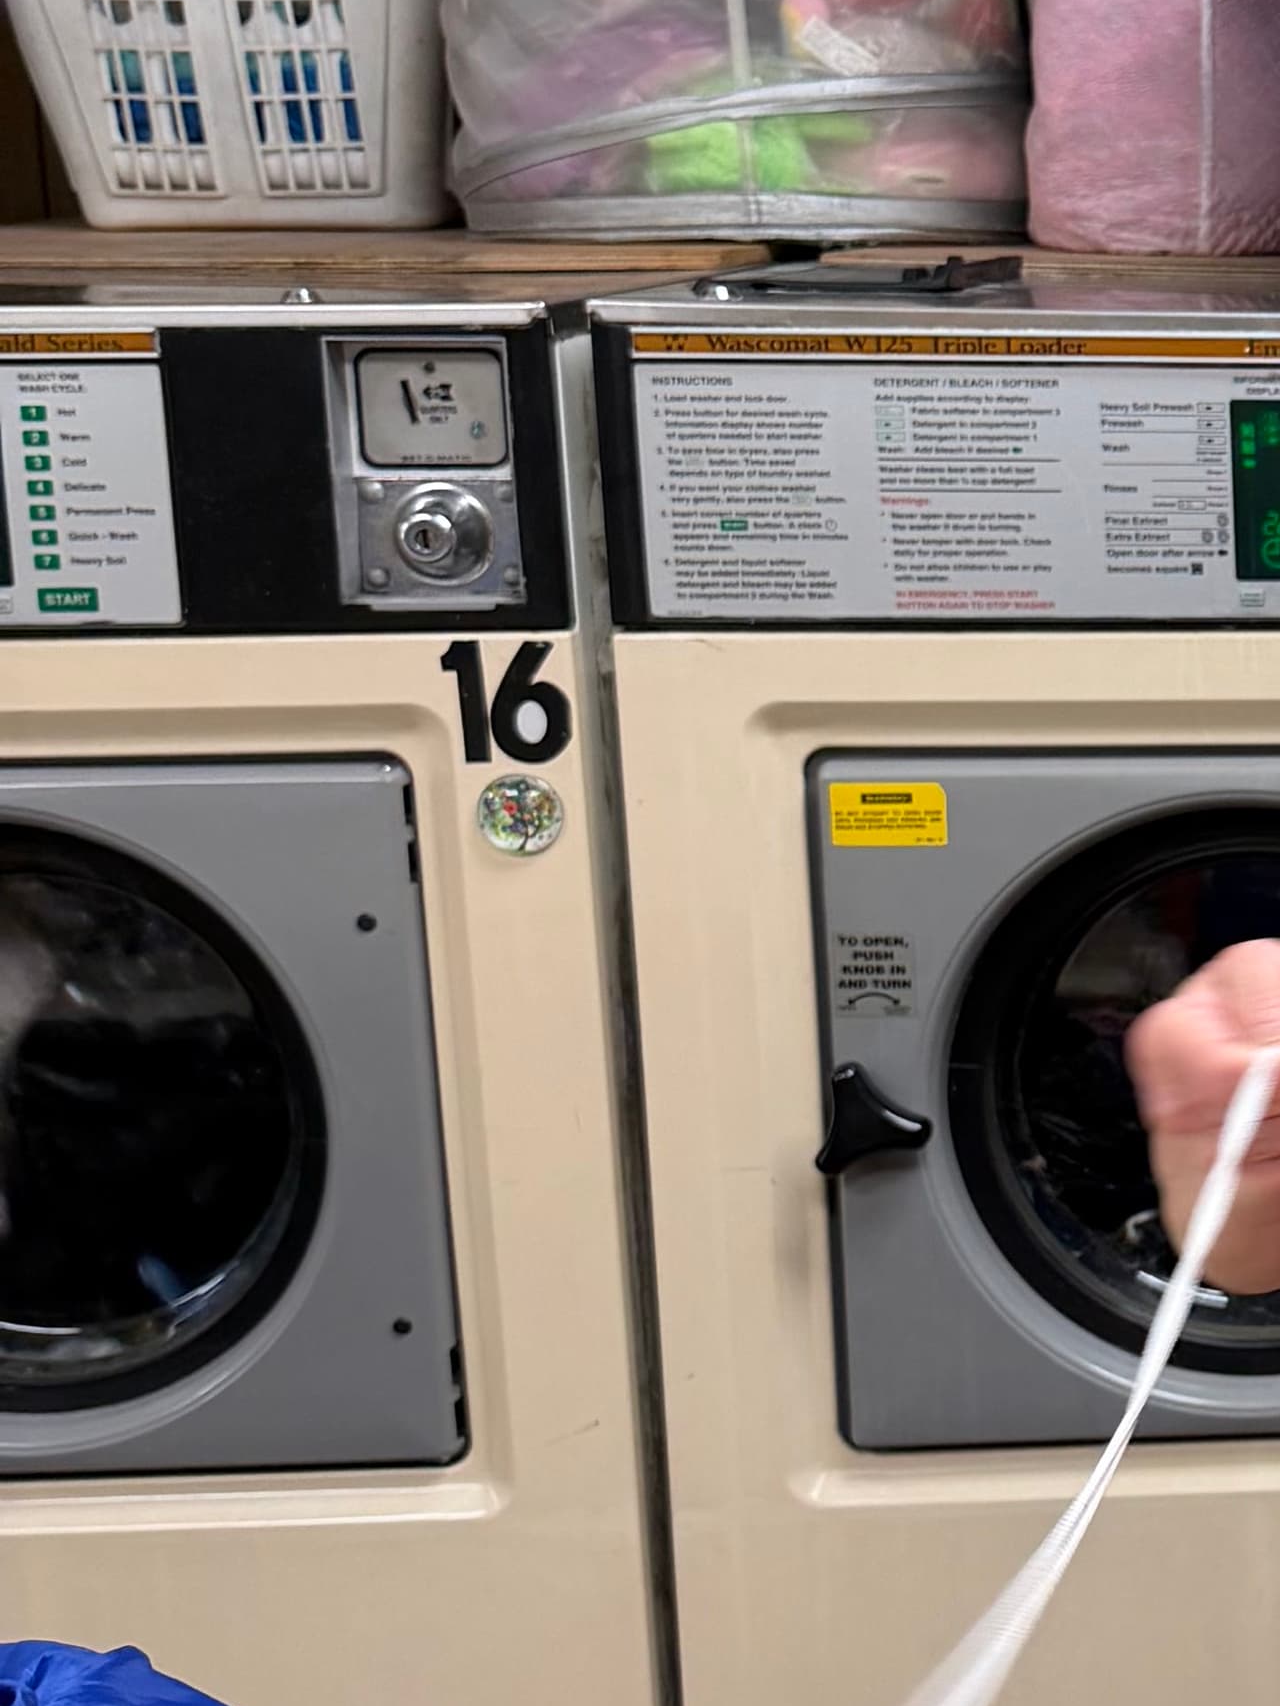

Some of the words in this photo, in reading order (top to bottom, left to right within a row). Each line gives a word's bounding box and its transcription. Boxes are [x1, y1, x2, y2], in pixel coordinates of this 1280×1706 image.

[47, 334, 123, 352] Series
[706, 334, 830, 353] Wascomat
[932, 336, 998, 355] Triple
[1006, 337, 1087, 355] Loader
[652, 376, 733, 387] INSTRUCTIONS
[874, 378, 939, 388] DETERGENT
[949, 379, 994, 388] BLEACH
[1001, 379, 1059, 389] SOFTENER
[29, 409, 37, 419] 1
[58, 408, 76, 417] Hot
[1100, 403, 1129, 413] Heavy
[31, 433, 40, 443] 2
[60, 433, 91, 442] Warm
[1102, 444, 1130, 452] Wash
[34, 458, 42, 468] 3
[62, 457, 87, 467] Cold
[36, 483, 45, 493] 4
[64, 482, 106, 492] Delicate
[38, 507, 47, 518] 5
[66, 507, 123, 516] Permanent
[126, 507, 156, 516] Press
[1133, 516, 1168, 525] Extract
[41, 532, 50, 542] 6
[69, 532, 99, 542] Quick
[109, 532, 138, 541] Wash
[1134, 532, 1170, 542] Extract
[1107, 549, 1133, 559] Open
[1136, 548, 1158, 557] door
[1162, 548, 1184, 557] after
[43, 557, 52, 567] 7
[71, 557, 103, 567] Heavy
[44, 593, 91, 606] START
[440, 640, 573, 763] 16
[837, 936, 858, 947] TO
[852, 950, 894, 960] PUSH
[843, 964, 886, 975] KNOB
[890, 964, 906, 975] IN
[838, 978, 870, 989] AND
[874, 978, 911, 989] TURN
